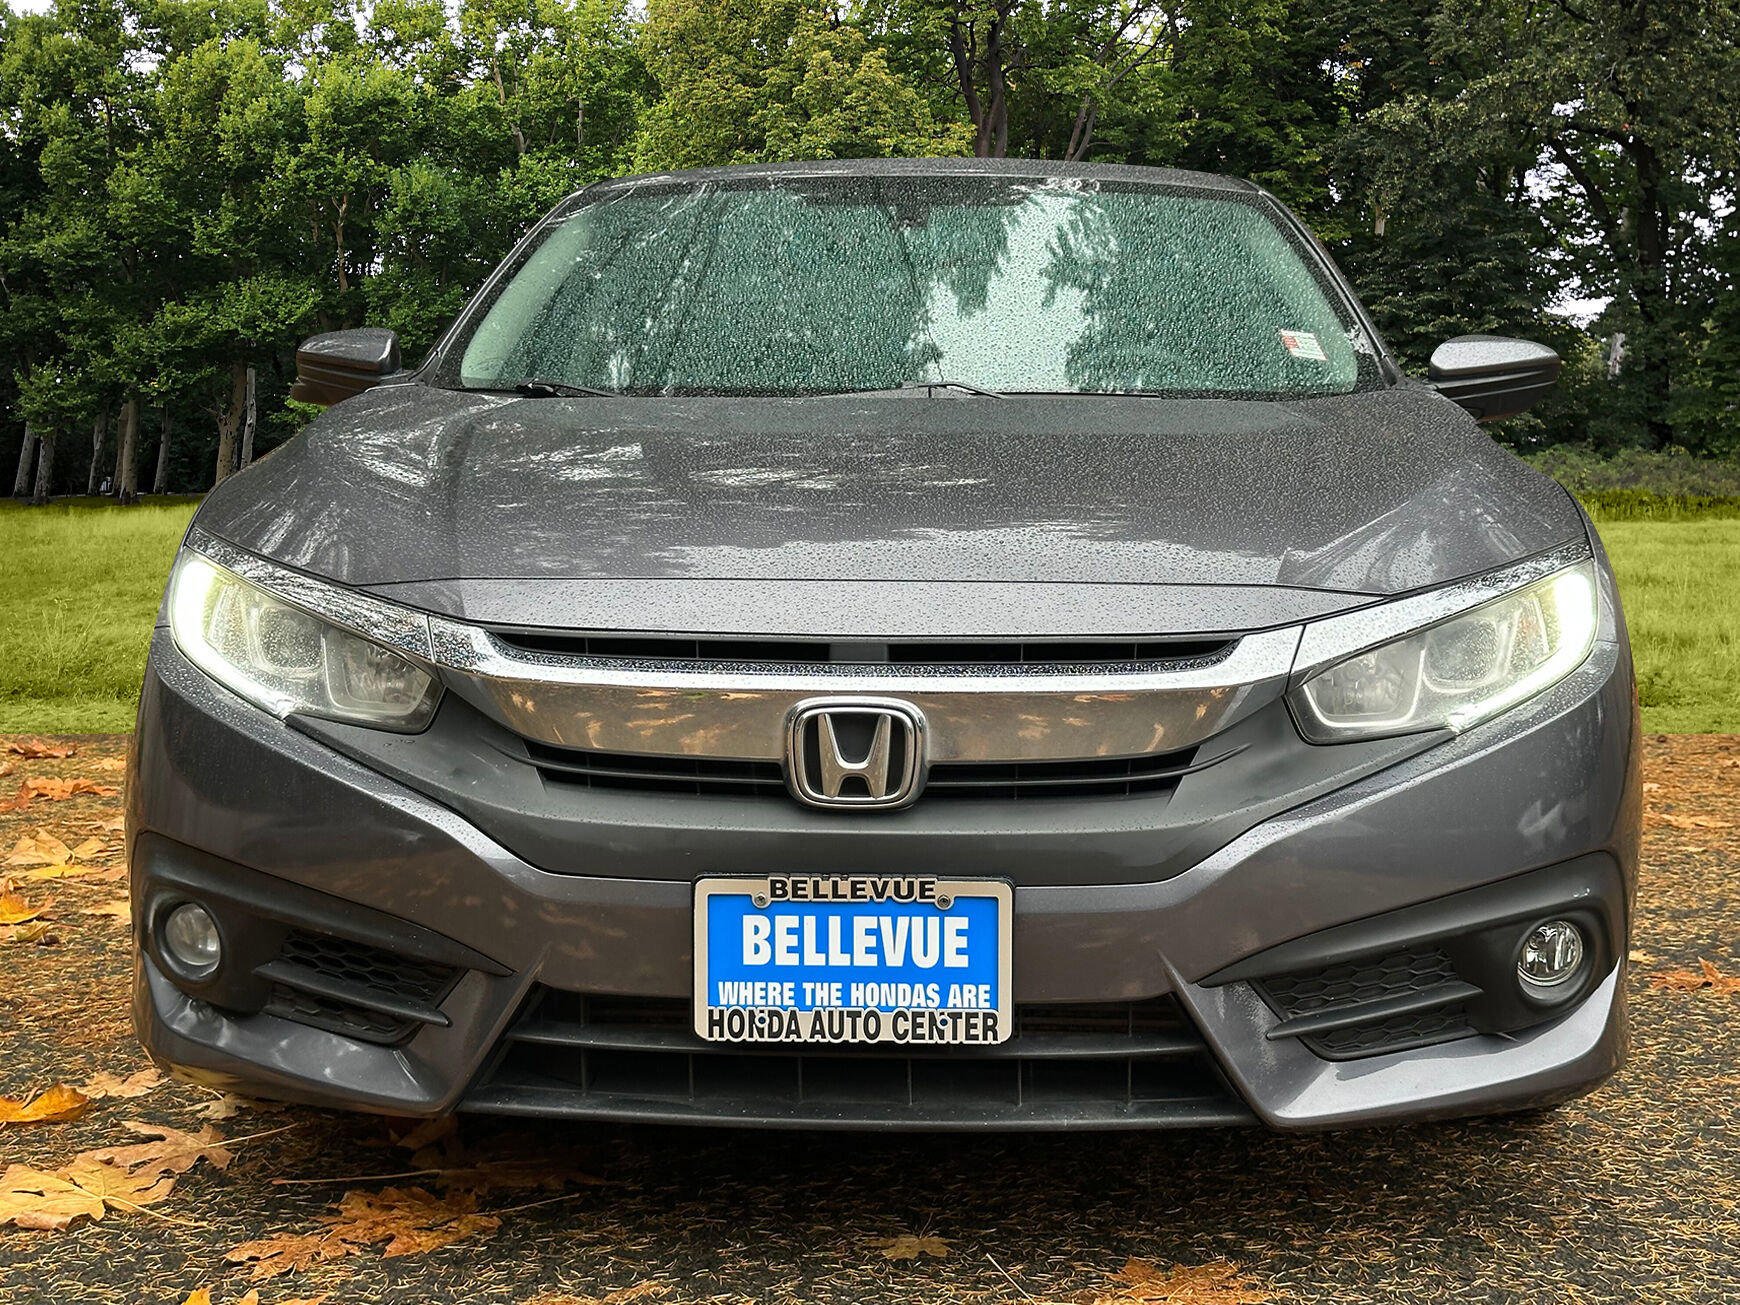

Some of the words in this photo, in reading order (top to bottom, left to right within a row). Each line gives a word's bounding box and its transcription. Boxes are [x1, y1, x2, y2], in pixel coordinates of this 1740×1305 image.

[768, 879, 937, 901] BELLEVUE
[742, 914, 969, 968] BELLEVUE
[718, 981, 795, 1006] WHERE
[802, 982, 842, 1006] THE
[851, 983, 941, 1008] HONDAS
[947, 984, 991, 1008] ARE
[708, 1010, 797, 1040] HONDA
[809, 1010, 881, 1040] AUTO
[892, 1011, 999, 1042] CENTER
